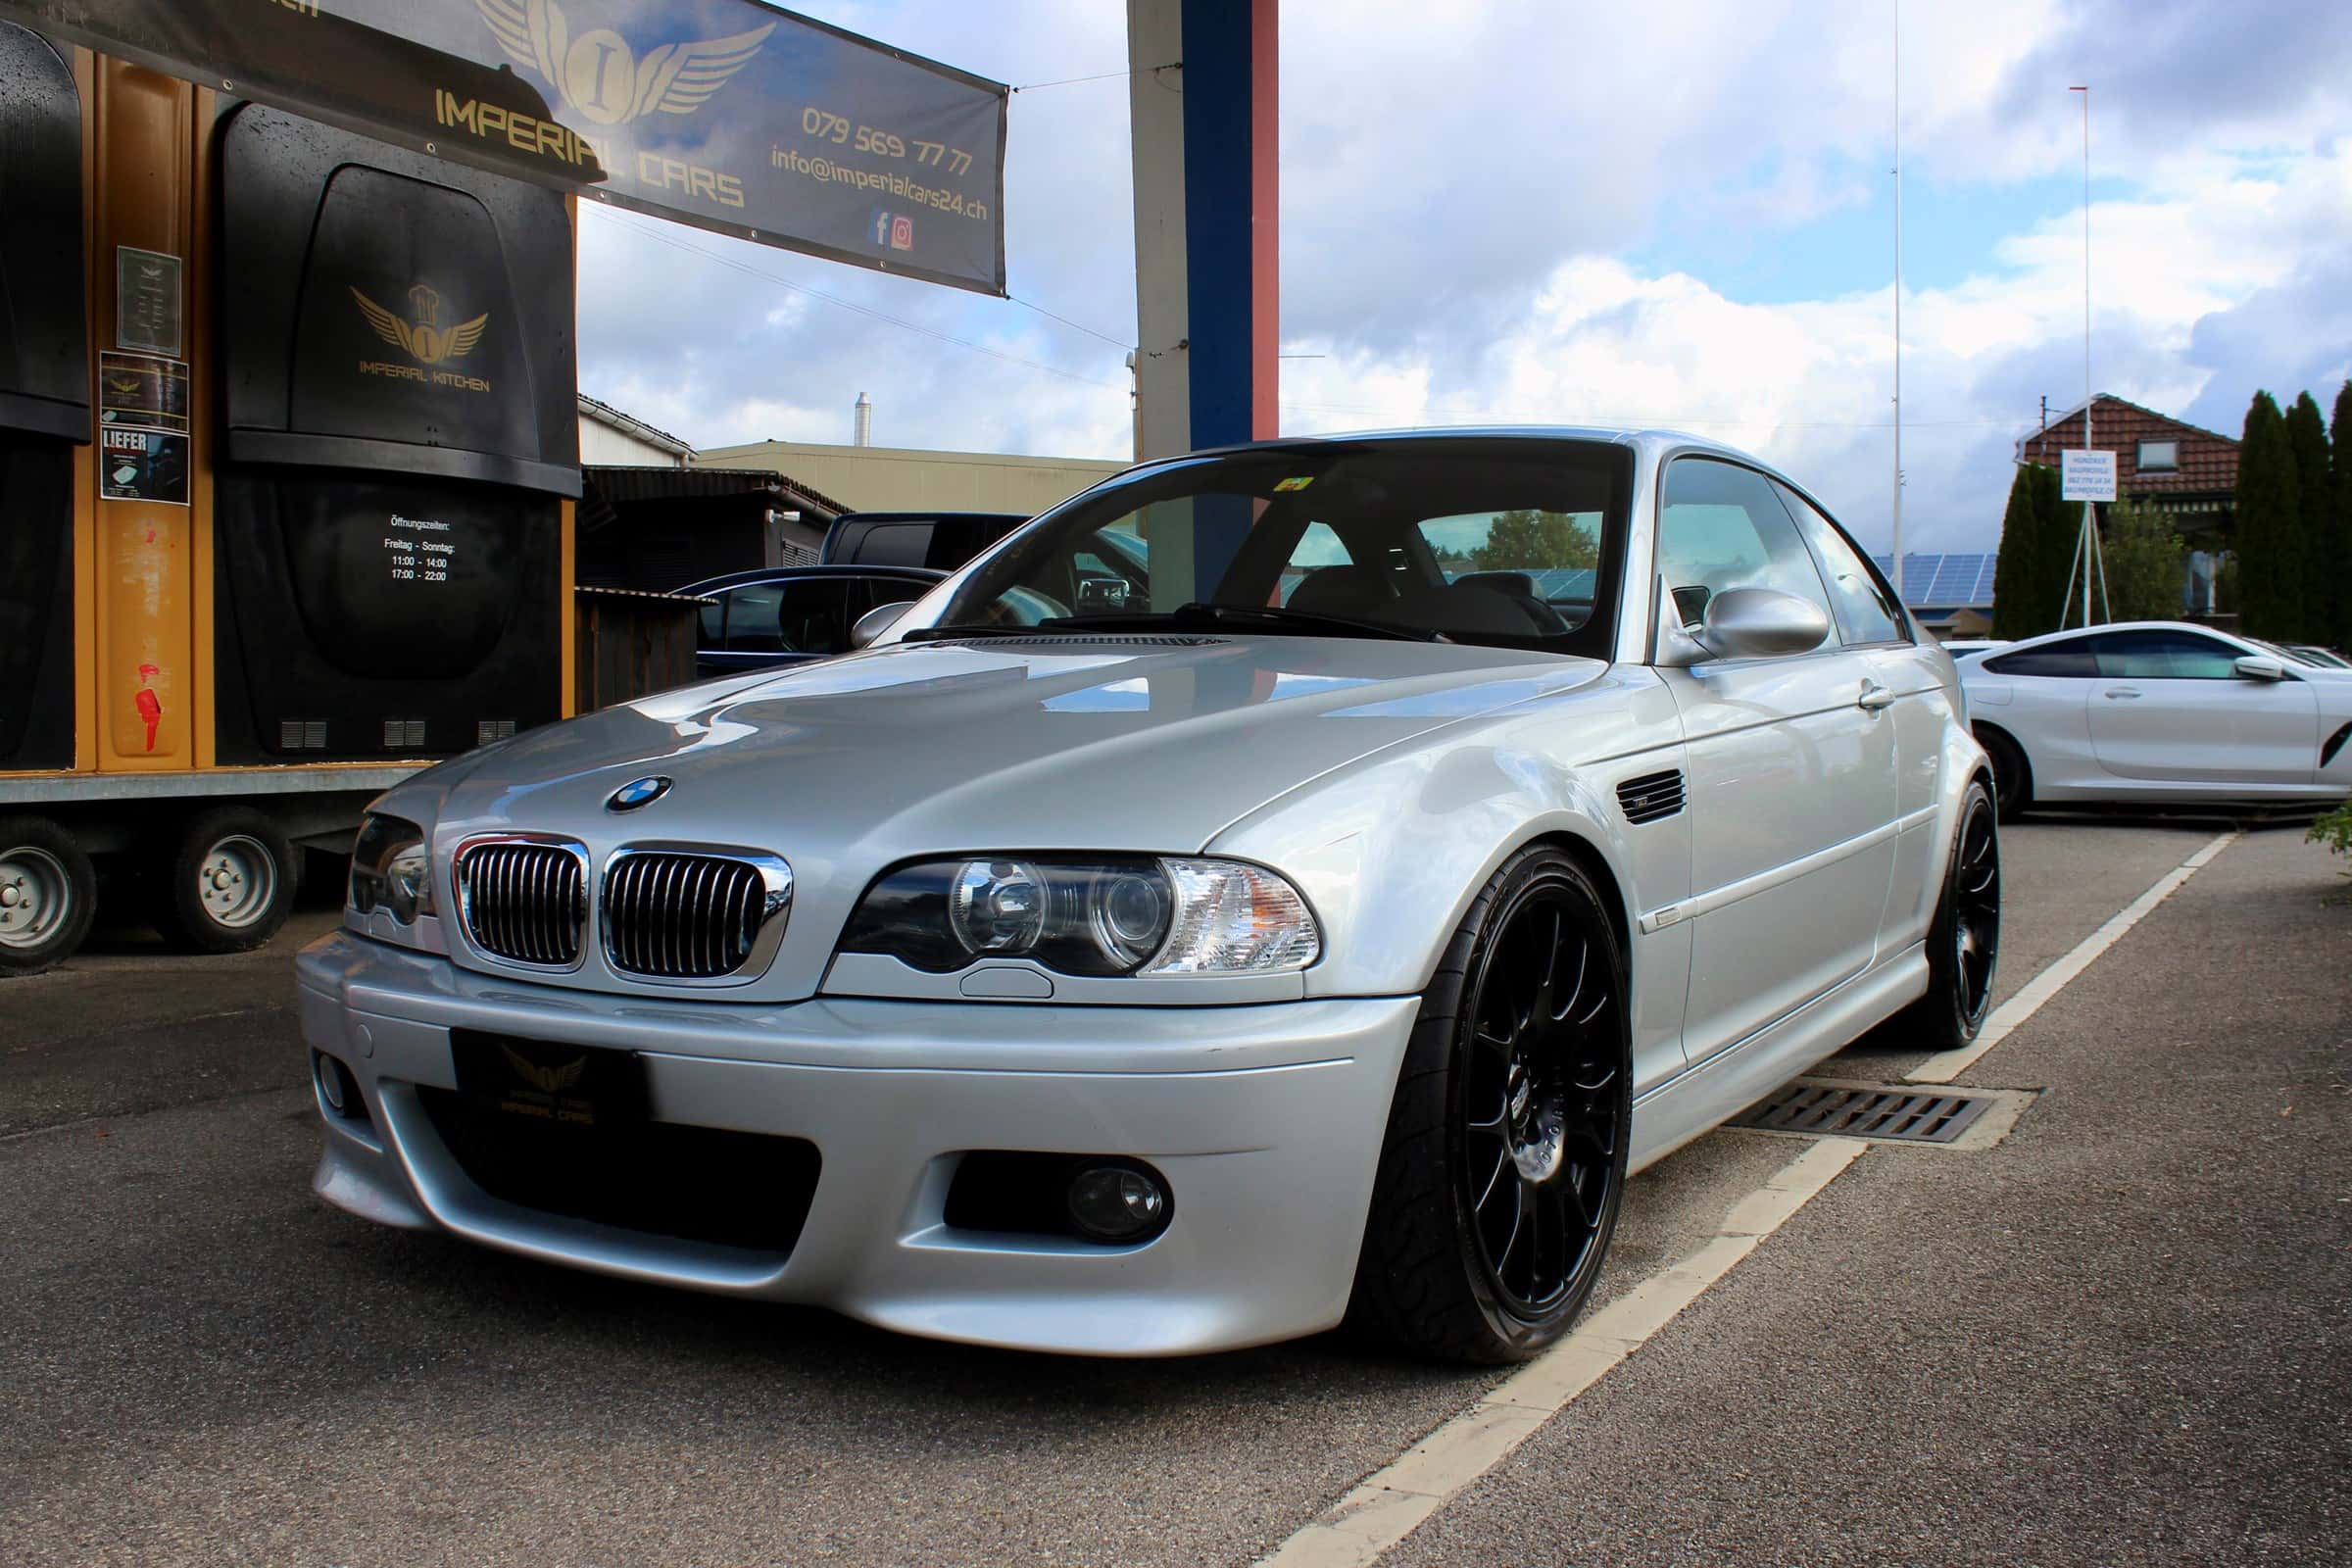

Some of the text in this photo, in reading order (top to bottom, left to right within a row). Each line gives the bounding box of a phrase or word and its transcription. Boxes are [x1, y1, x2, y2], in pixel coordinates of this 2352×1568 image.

[435, 89, 745, 208] IMPERIAL CARS
[802, 107, 973, 176] 079 569 77 77
[770, 144, 988, 220] info@imperialcars24.ch
[360, 361, 490, 393] IMPERIAL KITCHEN
[103, 430, 147, 451] LIEFER
[384, 538, 413, 551] Freitag
[392, 556, 415, 565] 11:00
[426, 558, 447, 568] 14:00
[392, 568, 414, 579] 17:00
[424, 570, 446, 581] 22:00
